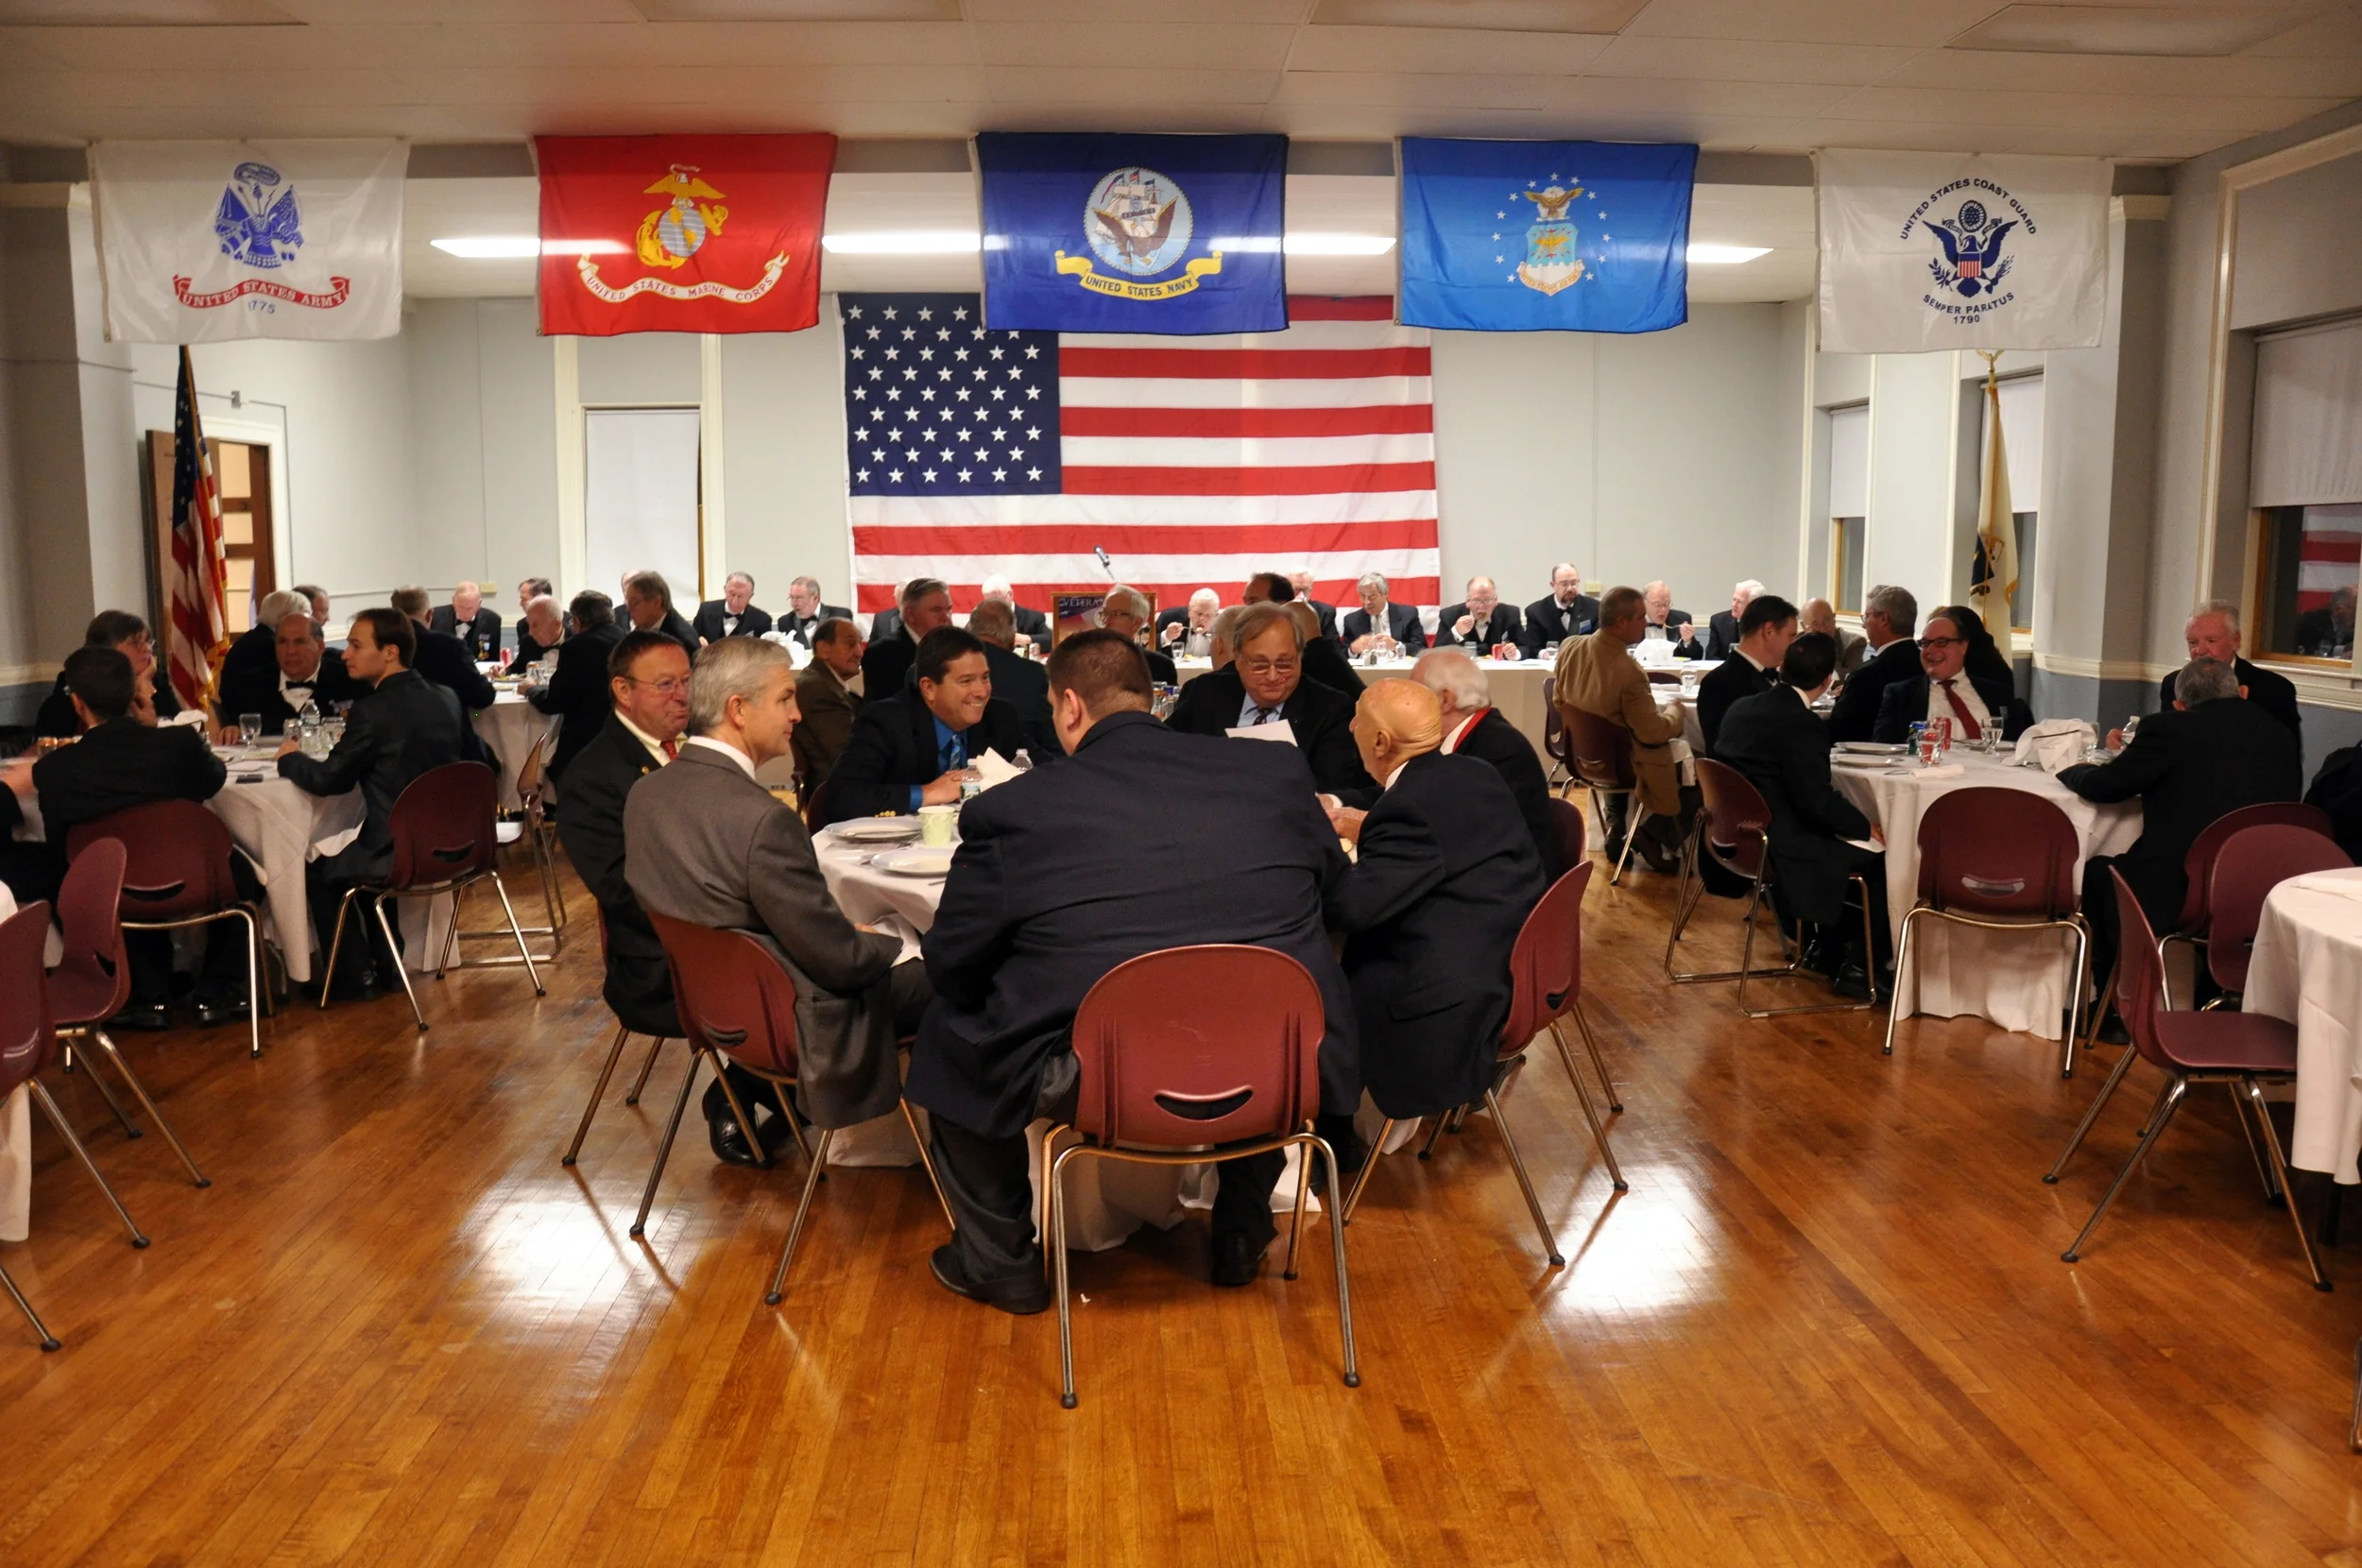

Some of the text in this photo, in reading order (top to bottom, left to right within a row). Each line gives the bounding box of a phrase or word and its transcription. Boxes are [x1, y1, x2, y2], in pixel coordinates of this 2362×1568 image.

[1900, 179, 2036, 240] UNITED STATES COAST GUARD
[182, 281, 343, 307] UNITED STATES ARMY
[587, 277, 773, 300] UNITED STATES MARINE CORPS
[1086, 276, 1192, 297] UNITED STATES NAVY
[248, 299, 276, 314] 1775
[1923, 292, 2014, 314] SEMPER PARATUS
[1953, 315, 1980, 324] 1790
